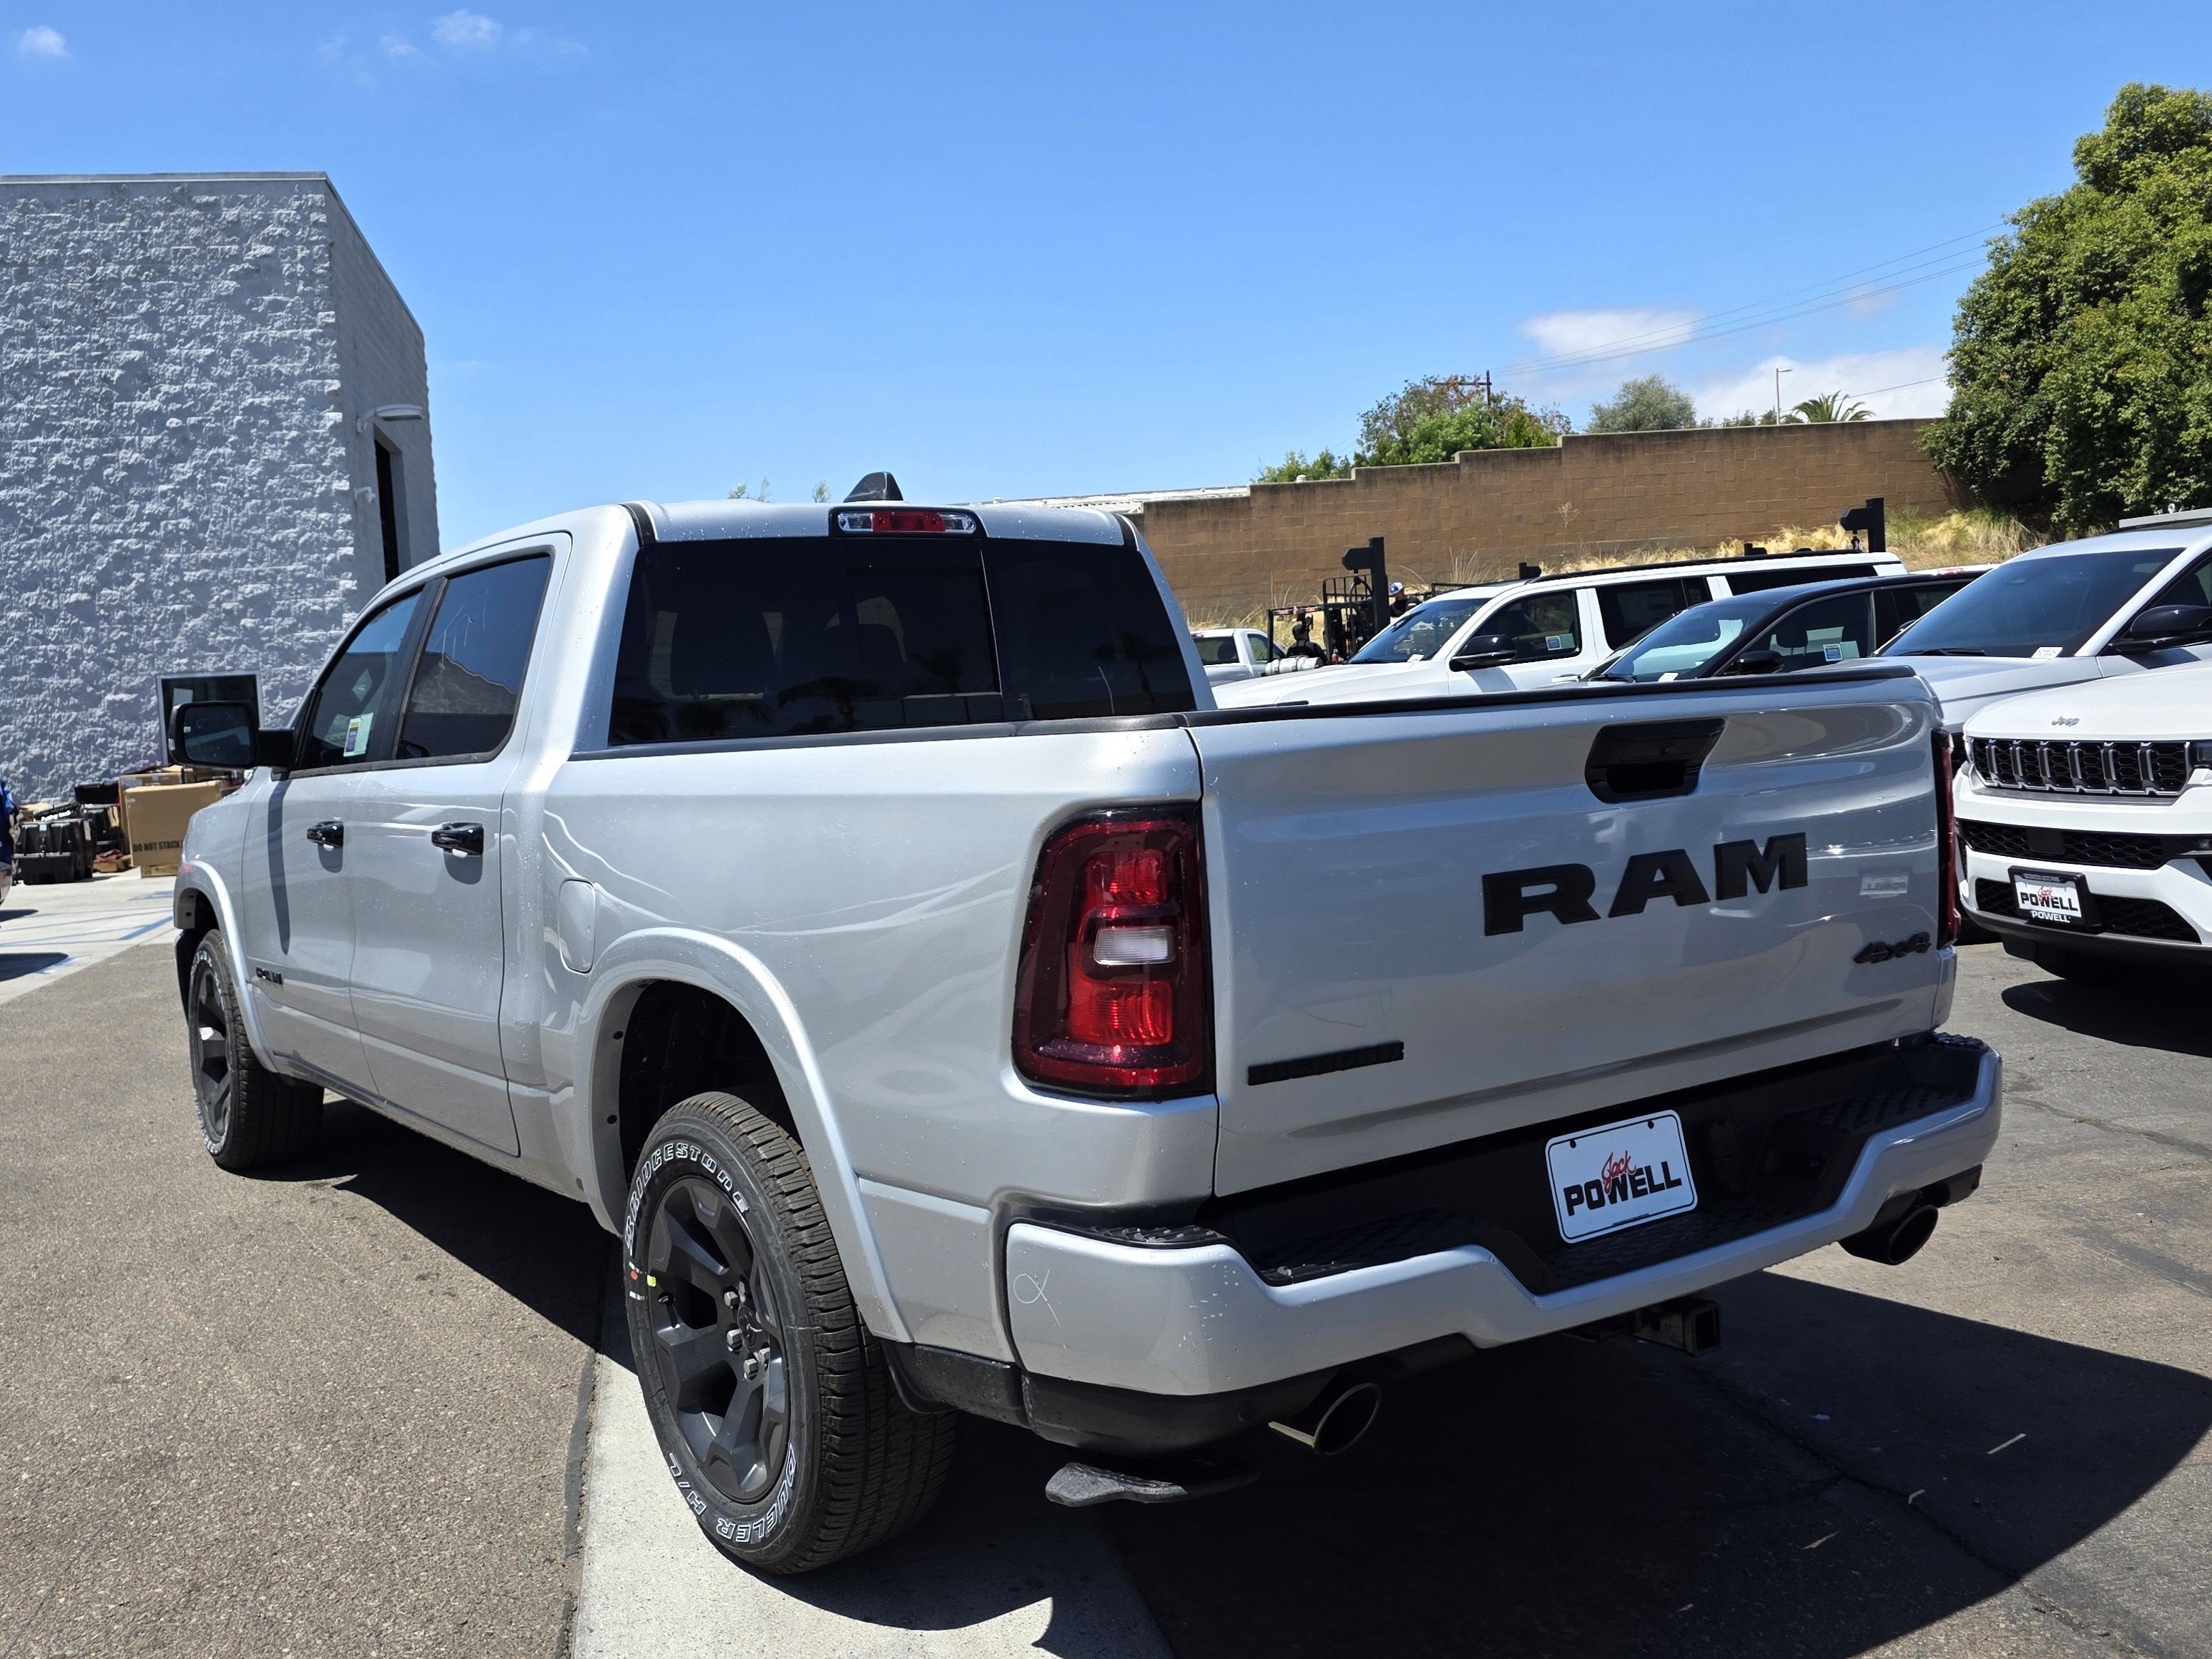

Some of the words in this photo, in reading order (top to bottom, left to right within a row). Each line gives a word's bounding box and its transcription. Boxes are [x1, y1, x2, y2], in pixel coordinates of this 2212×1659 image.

[2051, 716, 2080, 727] Jeep
[133, 843, 142, 852] DO
[144, 842, 157, 851] NOT
[1483, 832, 1808, 935] RAM
[2020, 892, 2078, 912] POWELL
[2031, 910, 2071, 923] POWELL
[1601, 1150, 1636, 1194] Jack
[1563, 1161, 1682, 1216] POWELL
[716, 1443, 797, 1543] DUELER
